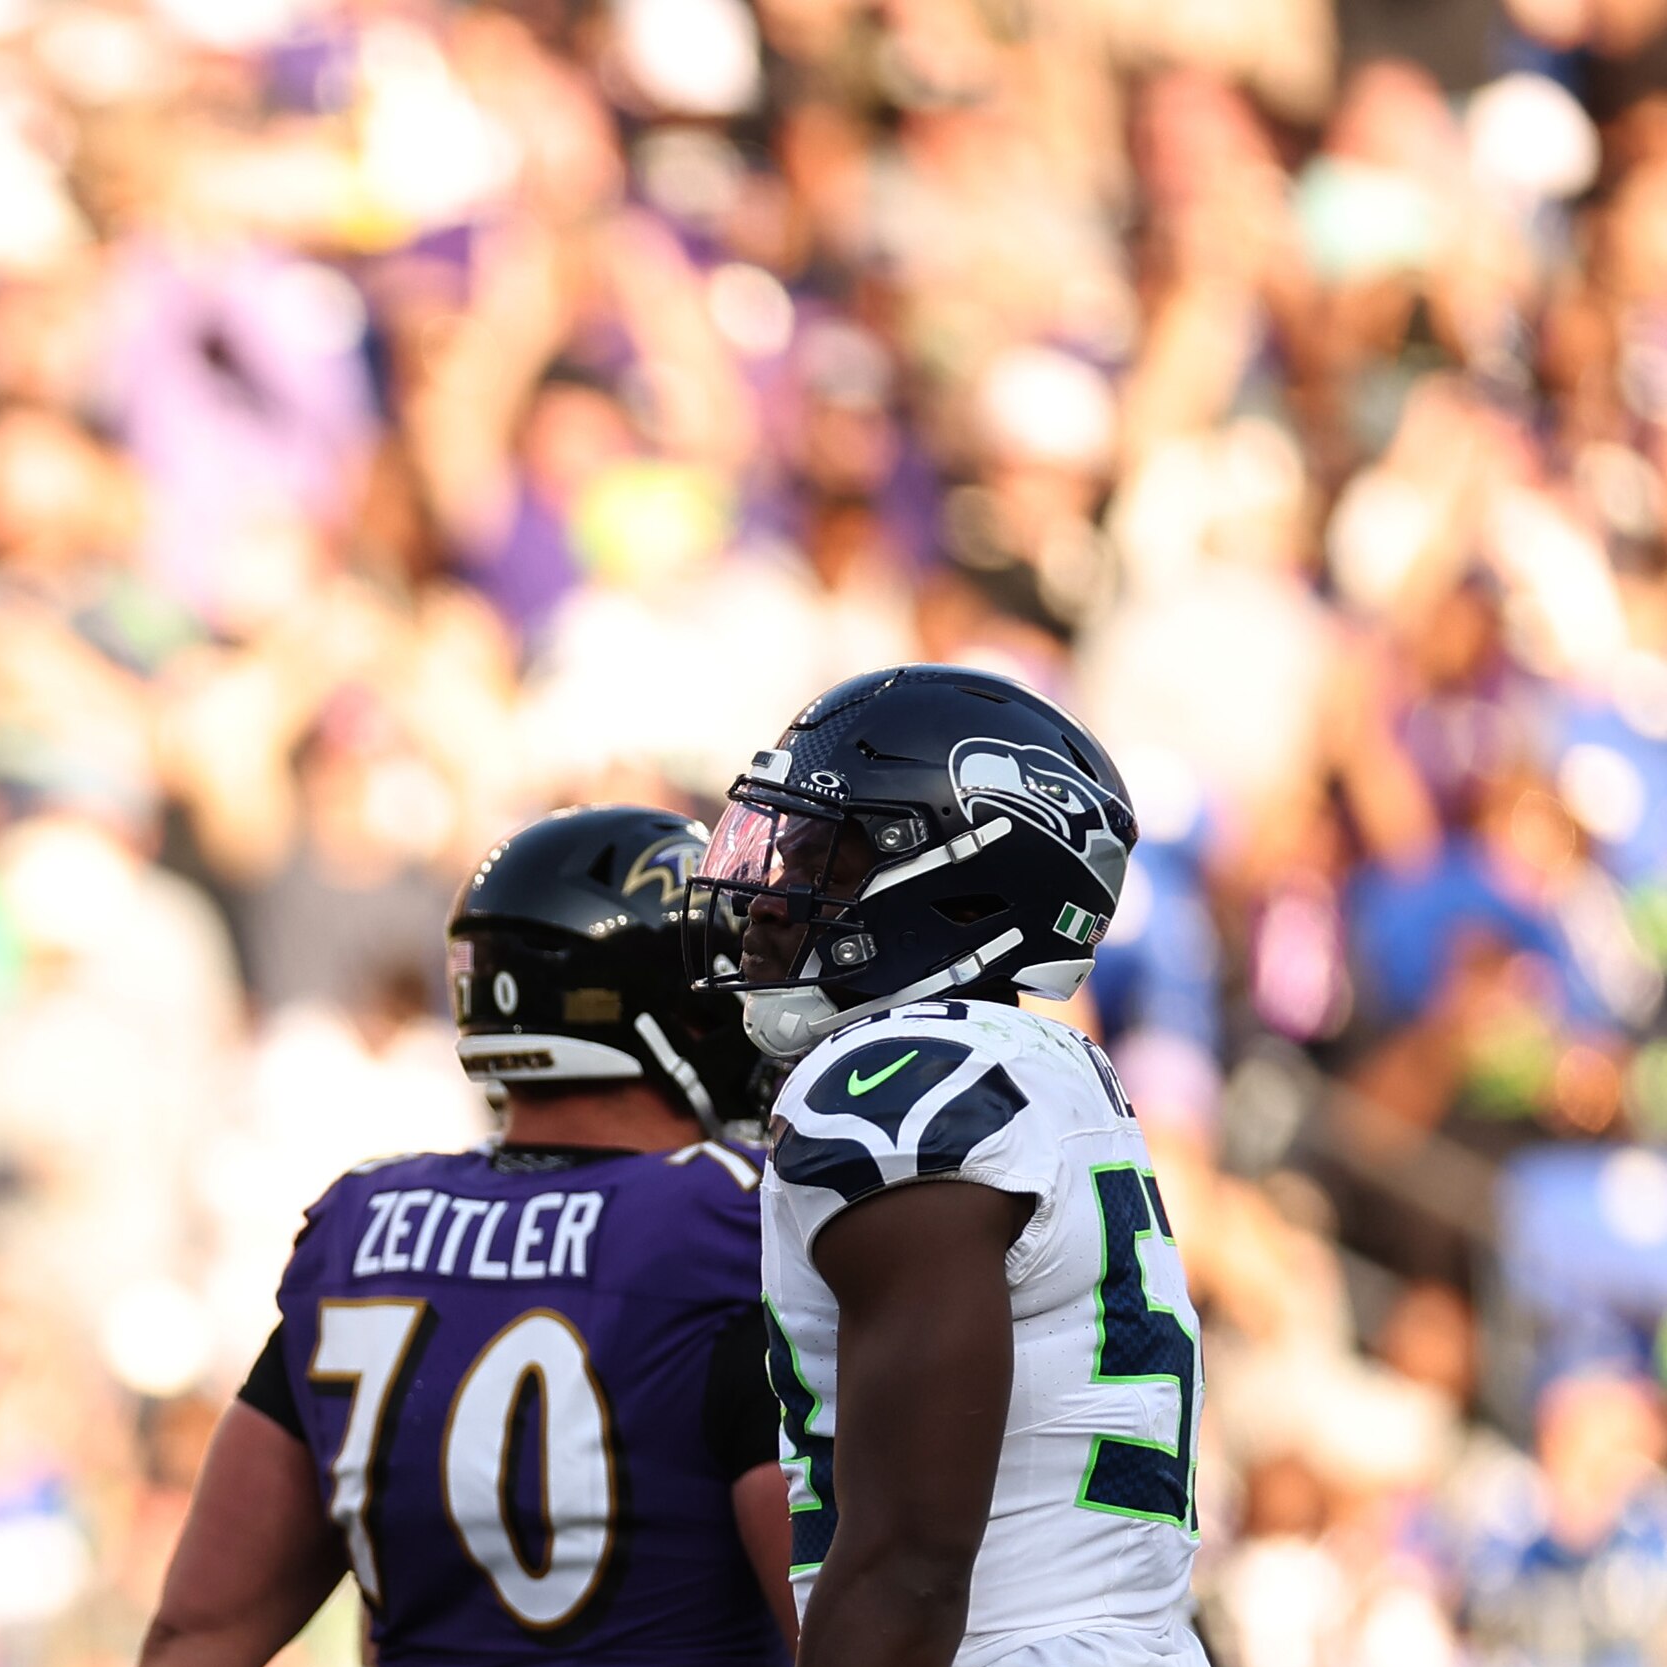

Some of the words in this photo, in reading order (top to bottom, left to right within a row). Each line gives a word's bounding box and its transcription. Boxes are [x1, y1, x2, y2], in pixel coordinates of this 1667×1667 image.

[800, 780, 846, 801] OAKLEY
[352, 1188, 605, 1281] ZEITLER
[306, 1296, 617, 1632] 70
